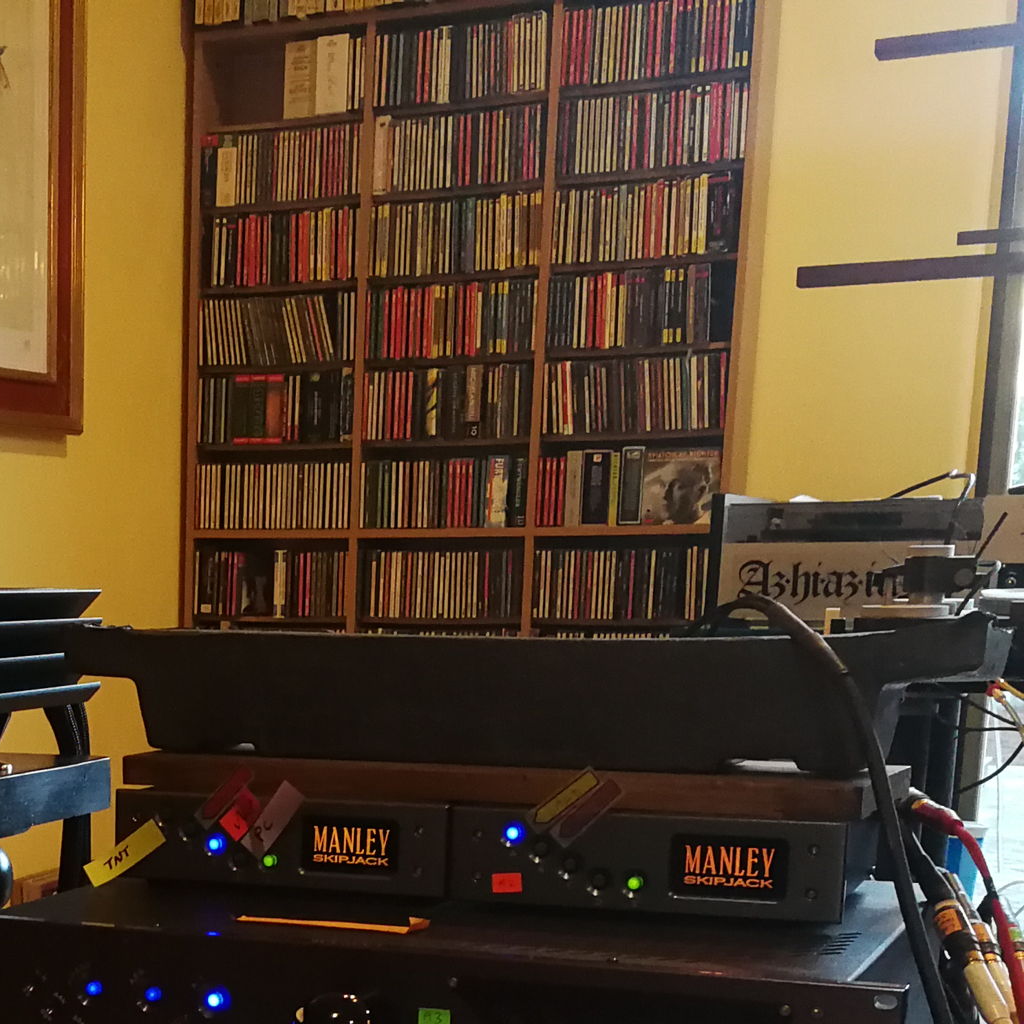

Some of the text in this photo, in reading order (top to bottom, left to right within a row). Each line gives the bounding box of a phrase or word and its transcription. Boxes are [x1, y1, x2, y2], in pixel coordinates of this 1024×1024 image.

[312, 824, 392, 857] MANLEY
[103, 844, 130, 870] TNT
[311, 853, 390, 868] SKIPJACK
[683, 844, 777, 878] MANLEY
[682, 875, 775, 890] SKIPJACK
